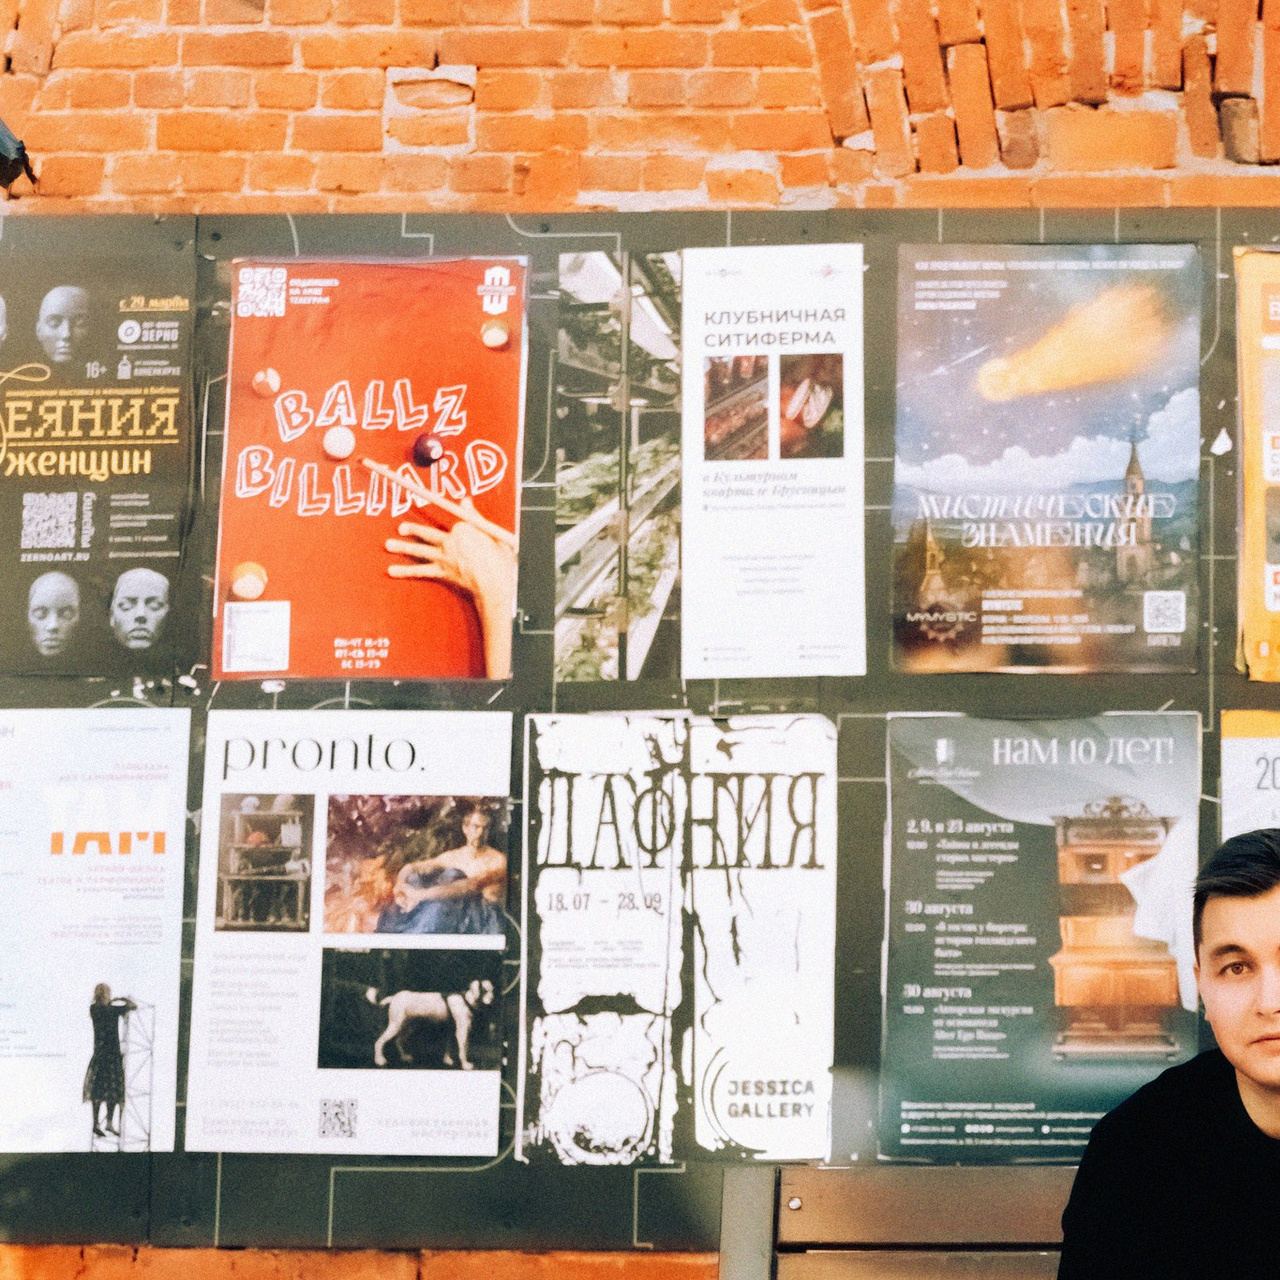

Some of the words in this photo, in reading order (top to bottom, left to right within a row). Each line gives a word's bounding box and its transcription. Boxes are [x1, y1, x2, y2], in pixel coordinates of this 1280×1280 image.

[705, 308, 847, 326] КЛУБНИЧНАЯ
[142, 329, 179, 342] ЗЕРНО
[704, 332, 836, 348] СИТИФЕРМА
[85, 361, 107, 379] 16+
[0, 398, 180, 440] ЕЯНИЯ
[274, 378, 468, 442] BALLZ
[5, 449, 152, 482] женщин
[235, 439, 509, 518] BILLIARD
[223, 734, 427, 781] pronto.
[538, 771, 828, 870] ДАФНИЯ
[965, 822, 1015, 837] августа
[924, 903, 974, 919] августа
[922, 986, 972, 1002] августа
[728, 1079, 816, 1097] JESSICA
[727, 1102, 816, 1119] GALLERY
